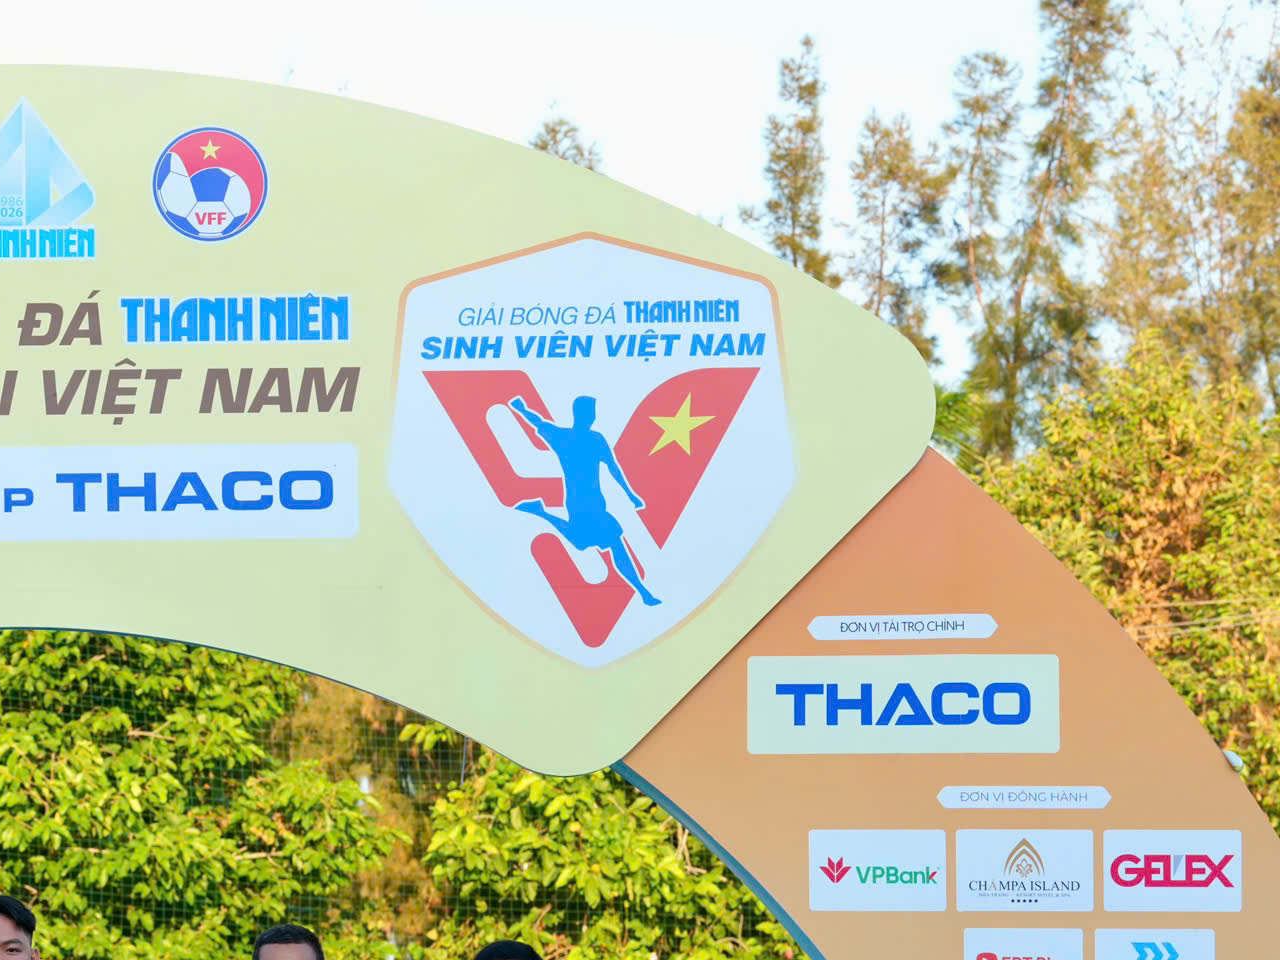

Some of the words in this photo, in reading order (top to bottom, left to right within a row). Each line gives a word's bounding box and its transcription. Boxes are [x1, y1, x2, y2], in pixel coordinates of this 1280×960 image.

[195, 212, 227, 225] VFF
[17, 290, 103, 347] ĐÁ
[121, 297, 253, 341] THANH
[259, 293, 349, 341] NIÊN
[458, 302, 504, 327] GIẢI
[509, 303, 578, 327] BÓNG
[584, 302, 616, 325] ĐÁ
[623, 300, 692, 324] THANH
[694, 298, 739, 323] NIÊN
[420, 336, 504, 360] SINH
[514, 330, 593, 359] VIÊN
[604, 329, 681, 362] VIỆT
[689, 333, 766, 356] NAM
[43, 358, 183, 425] VIỆT
[200, 366, 361, 414] NAM
[55, 470, 334, 512] THACO
[840, 621, 866, 632] ĐƠN
[882, 619, 899, 632] TÀI
[901, 620, 924, 634] TRỢ
[926, 618, 965, 631] CHÍNH
[775, 682, 1031, 726] THACO
[960, 791, 989, 802] ĐƠN
[1051, 790, 1088, 802] HÀNH
[856, 866, 938, 884] VPBank
[968, 880, 1026, 891] CHAMPA
[1030, 880, 1081, 891] ISLAND
[1110, 853, 1234, 888] GELEX
